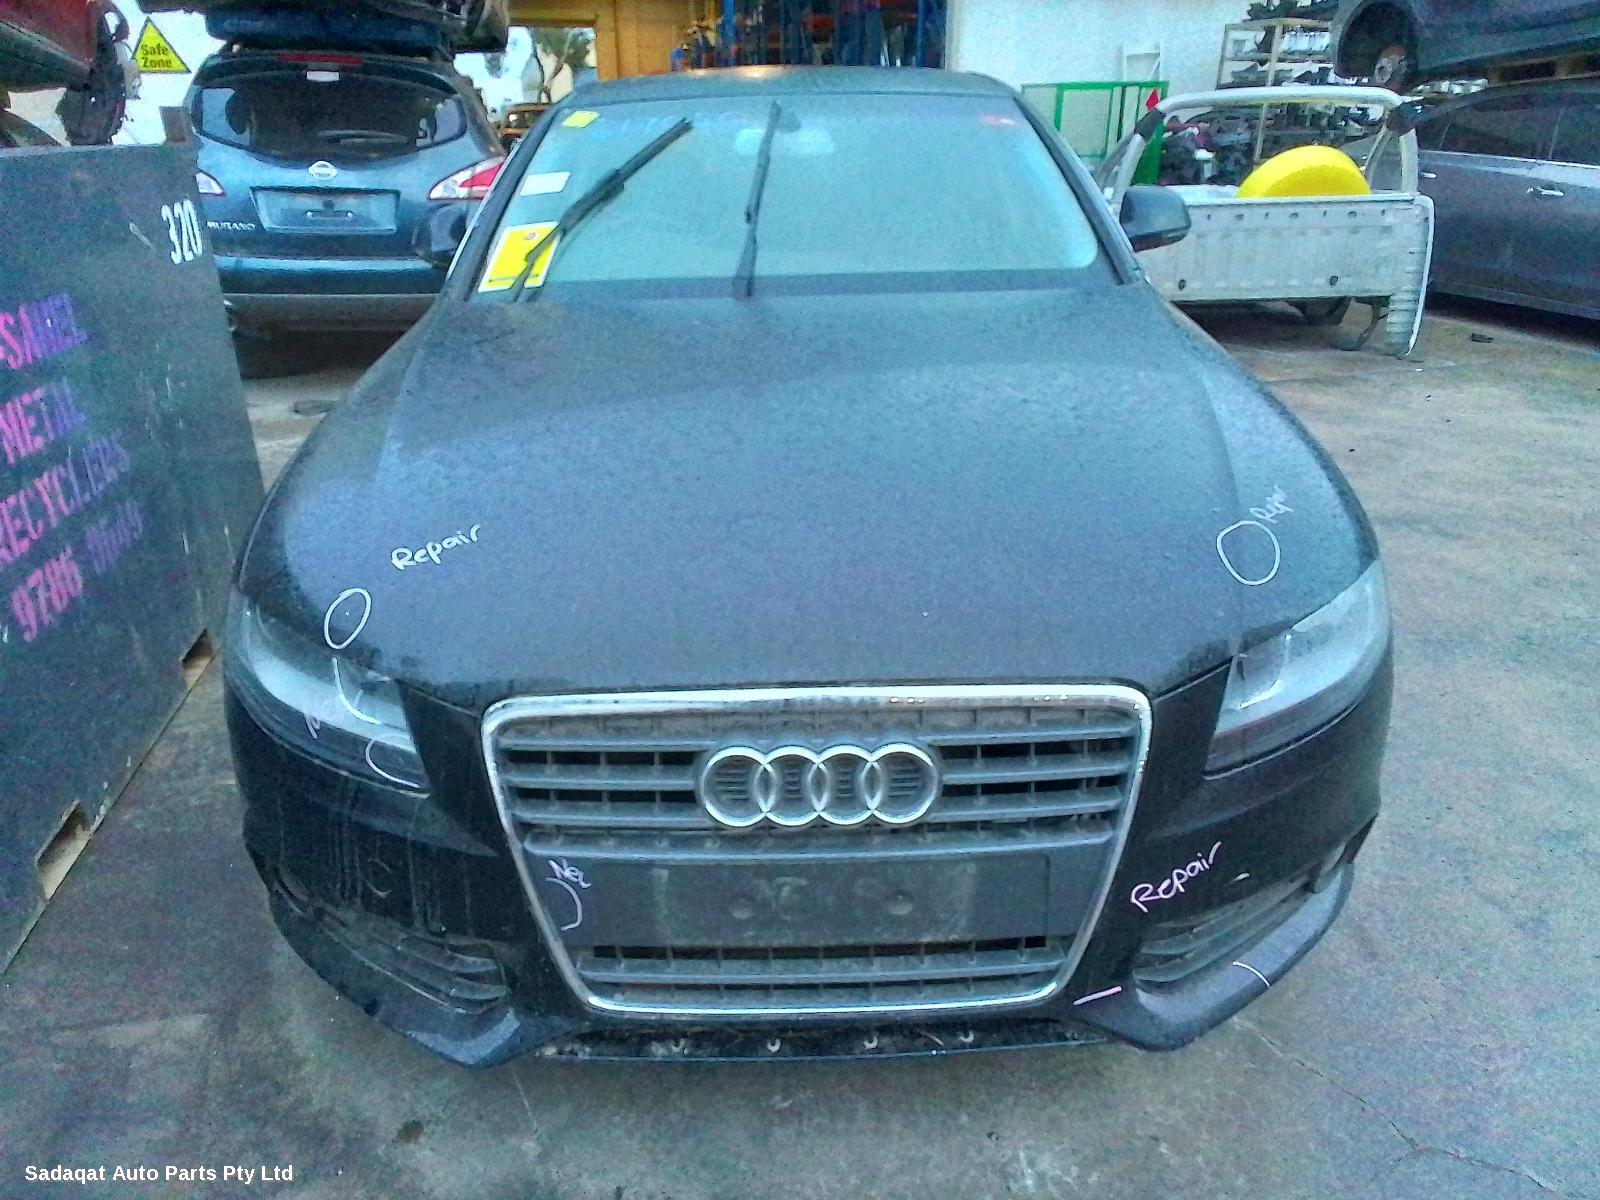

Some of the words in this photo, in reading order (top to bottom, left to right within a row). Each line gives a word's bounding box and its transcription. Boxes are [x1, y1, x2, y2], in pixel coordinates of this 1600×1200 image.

[141, 43, 169, 56] Safe
[142, 56, 172, 69] Zone
[161, 199, 203, 264] 320
[206, 221, 256, 230] MURANO
[391, 525, 480, 570] Repair
[1130, 840, 1222, 913] Repair
